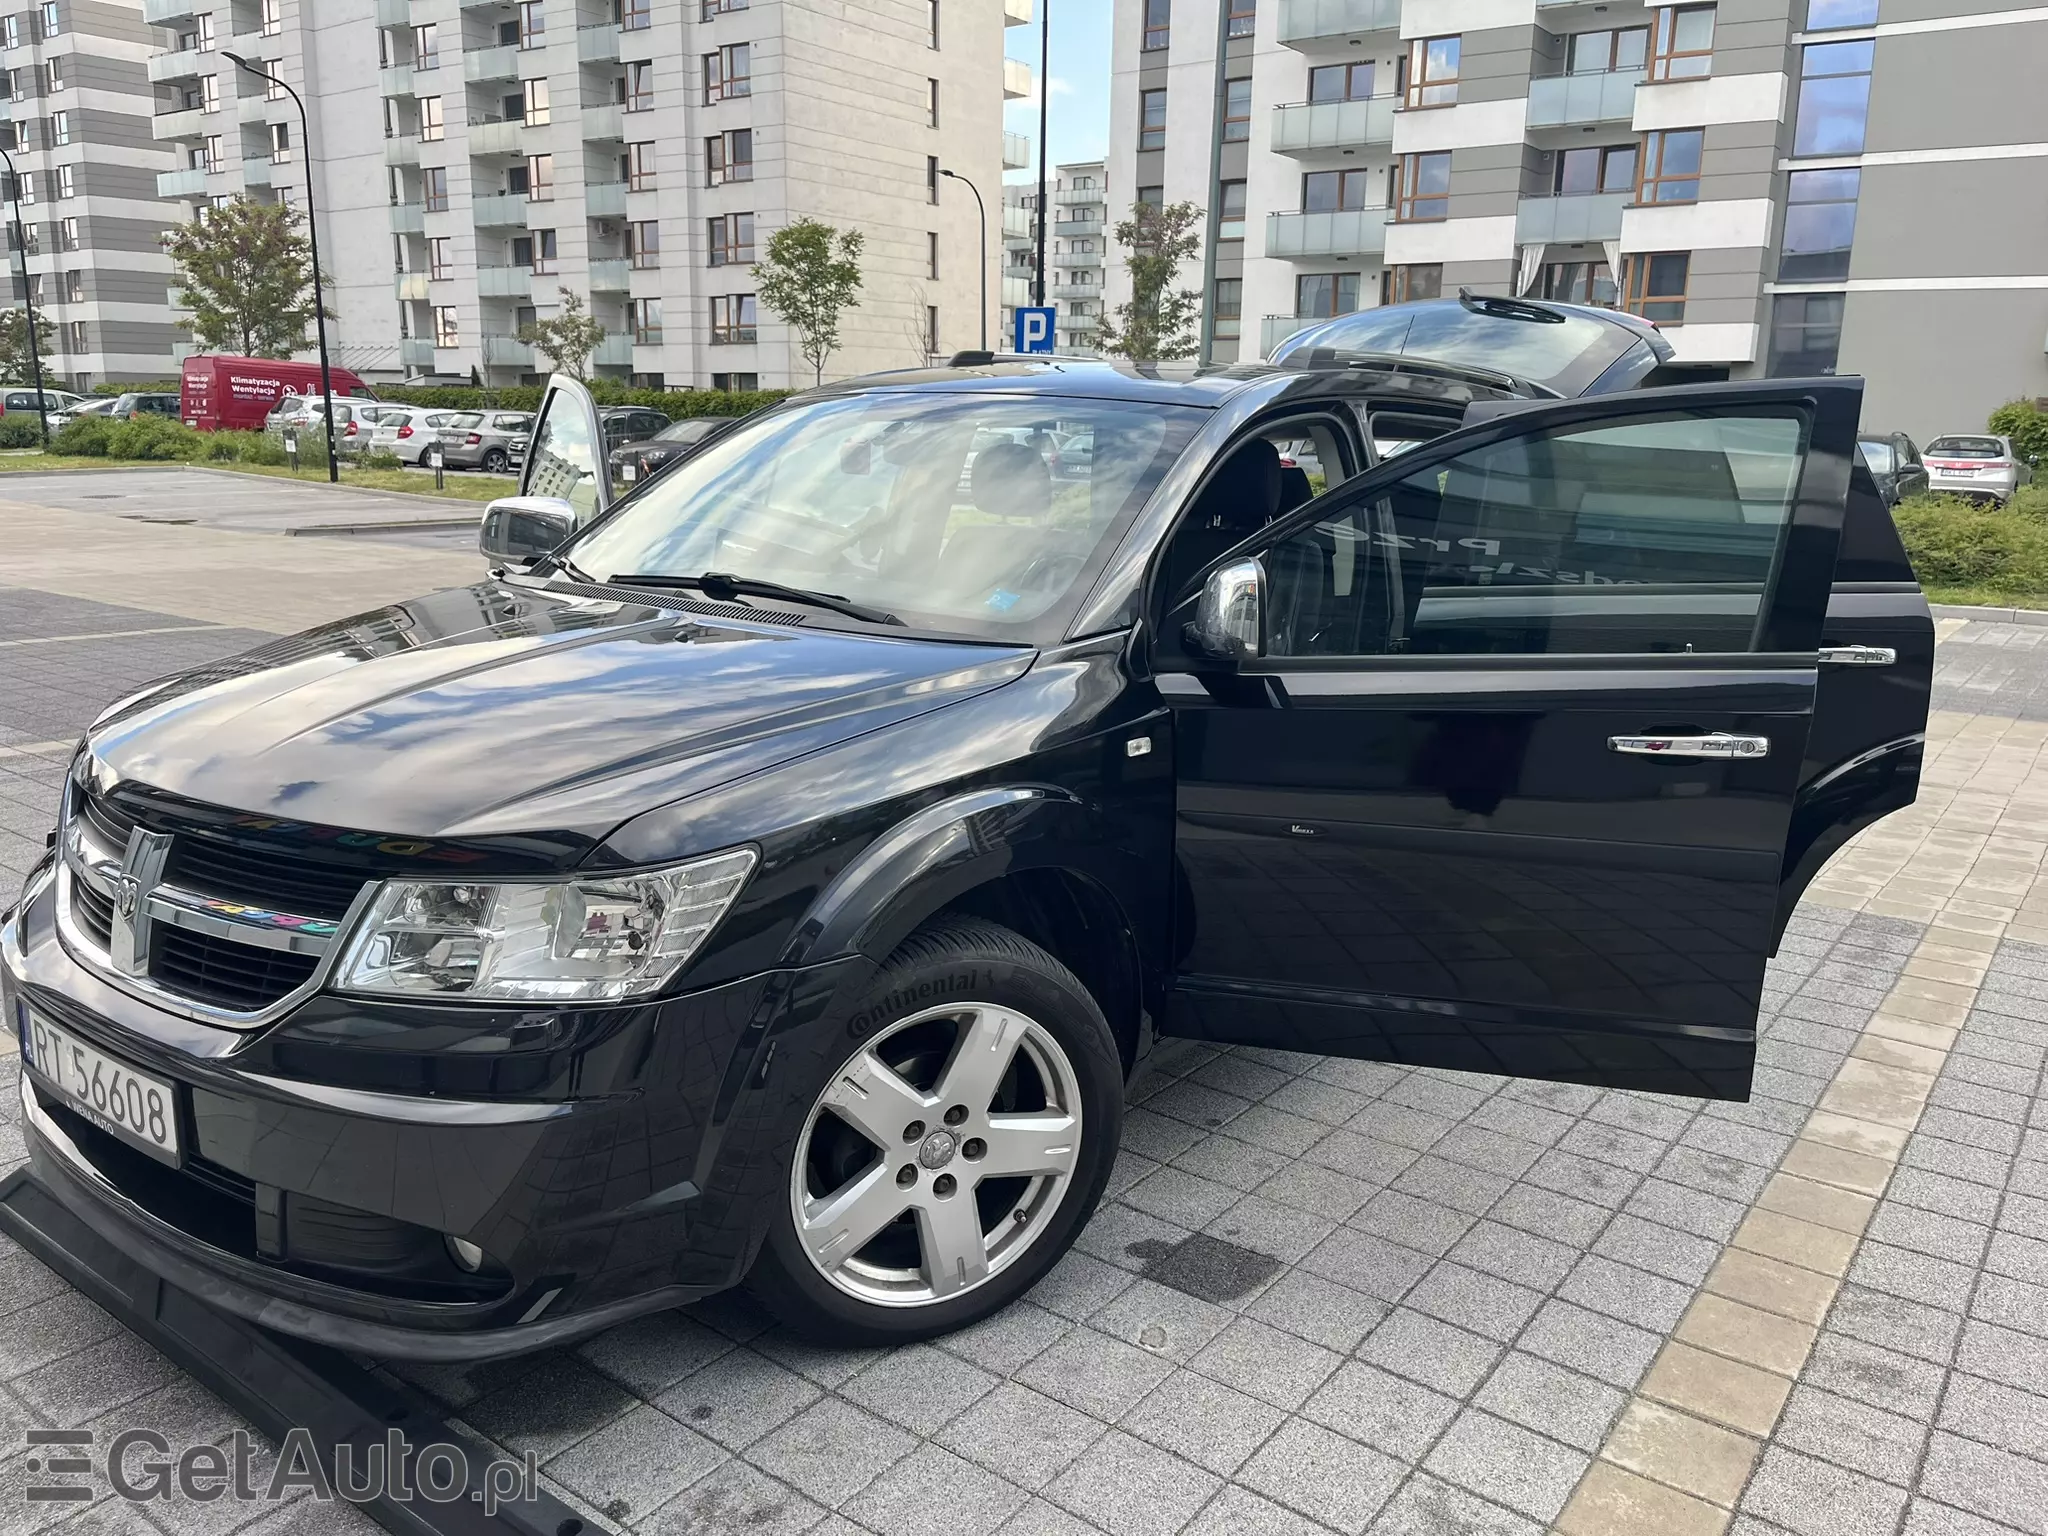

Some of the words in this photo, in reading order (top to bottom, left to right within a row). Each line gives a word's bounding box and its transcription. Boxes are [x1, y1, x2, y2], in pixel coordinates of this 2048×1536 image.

[1023, 312, 1046, 352] P
[230, 376, 280, 387] Klimatyzacja
[231, 385, 276, 395] Wentylacja
[846, 968, 977, 1040] Continental
[33, 1018, 62, 1085] RT
[72, 1044, 167, 1145] 56608
